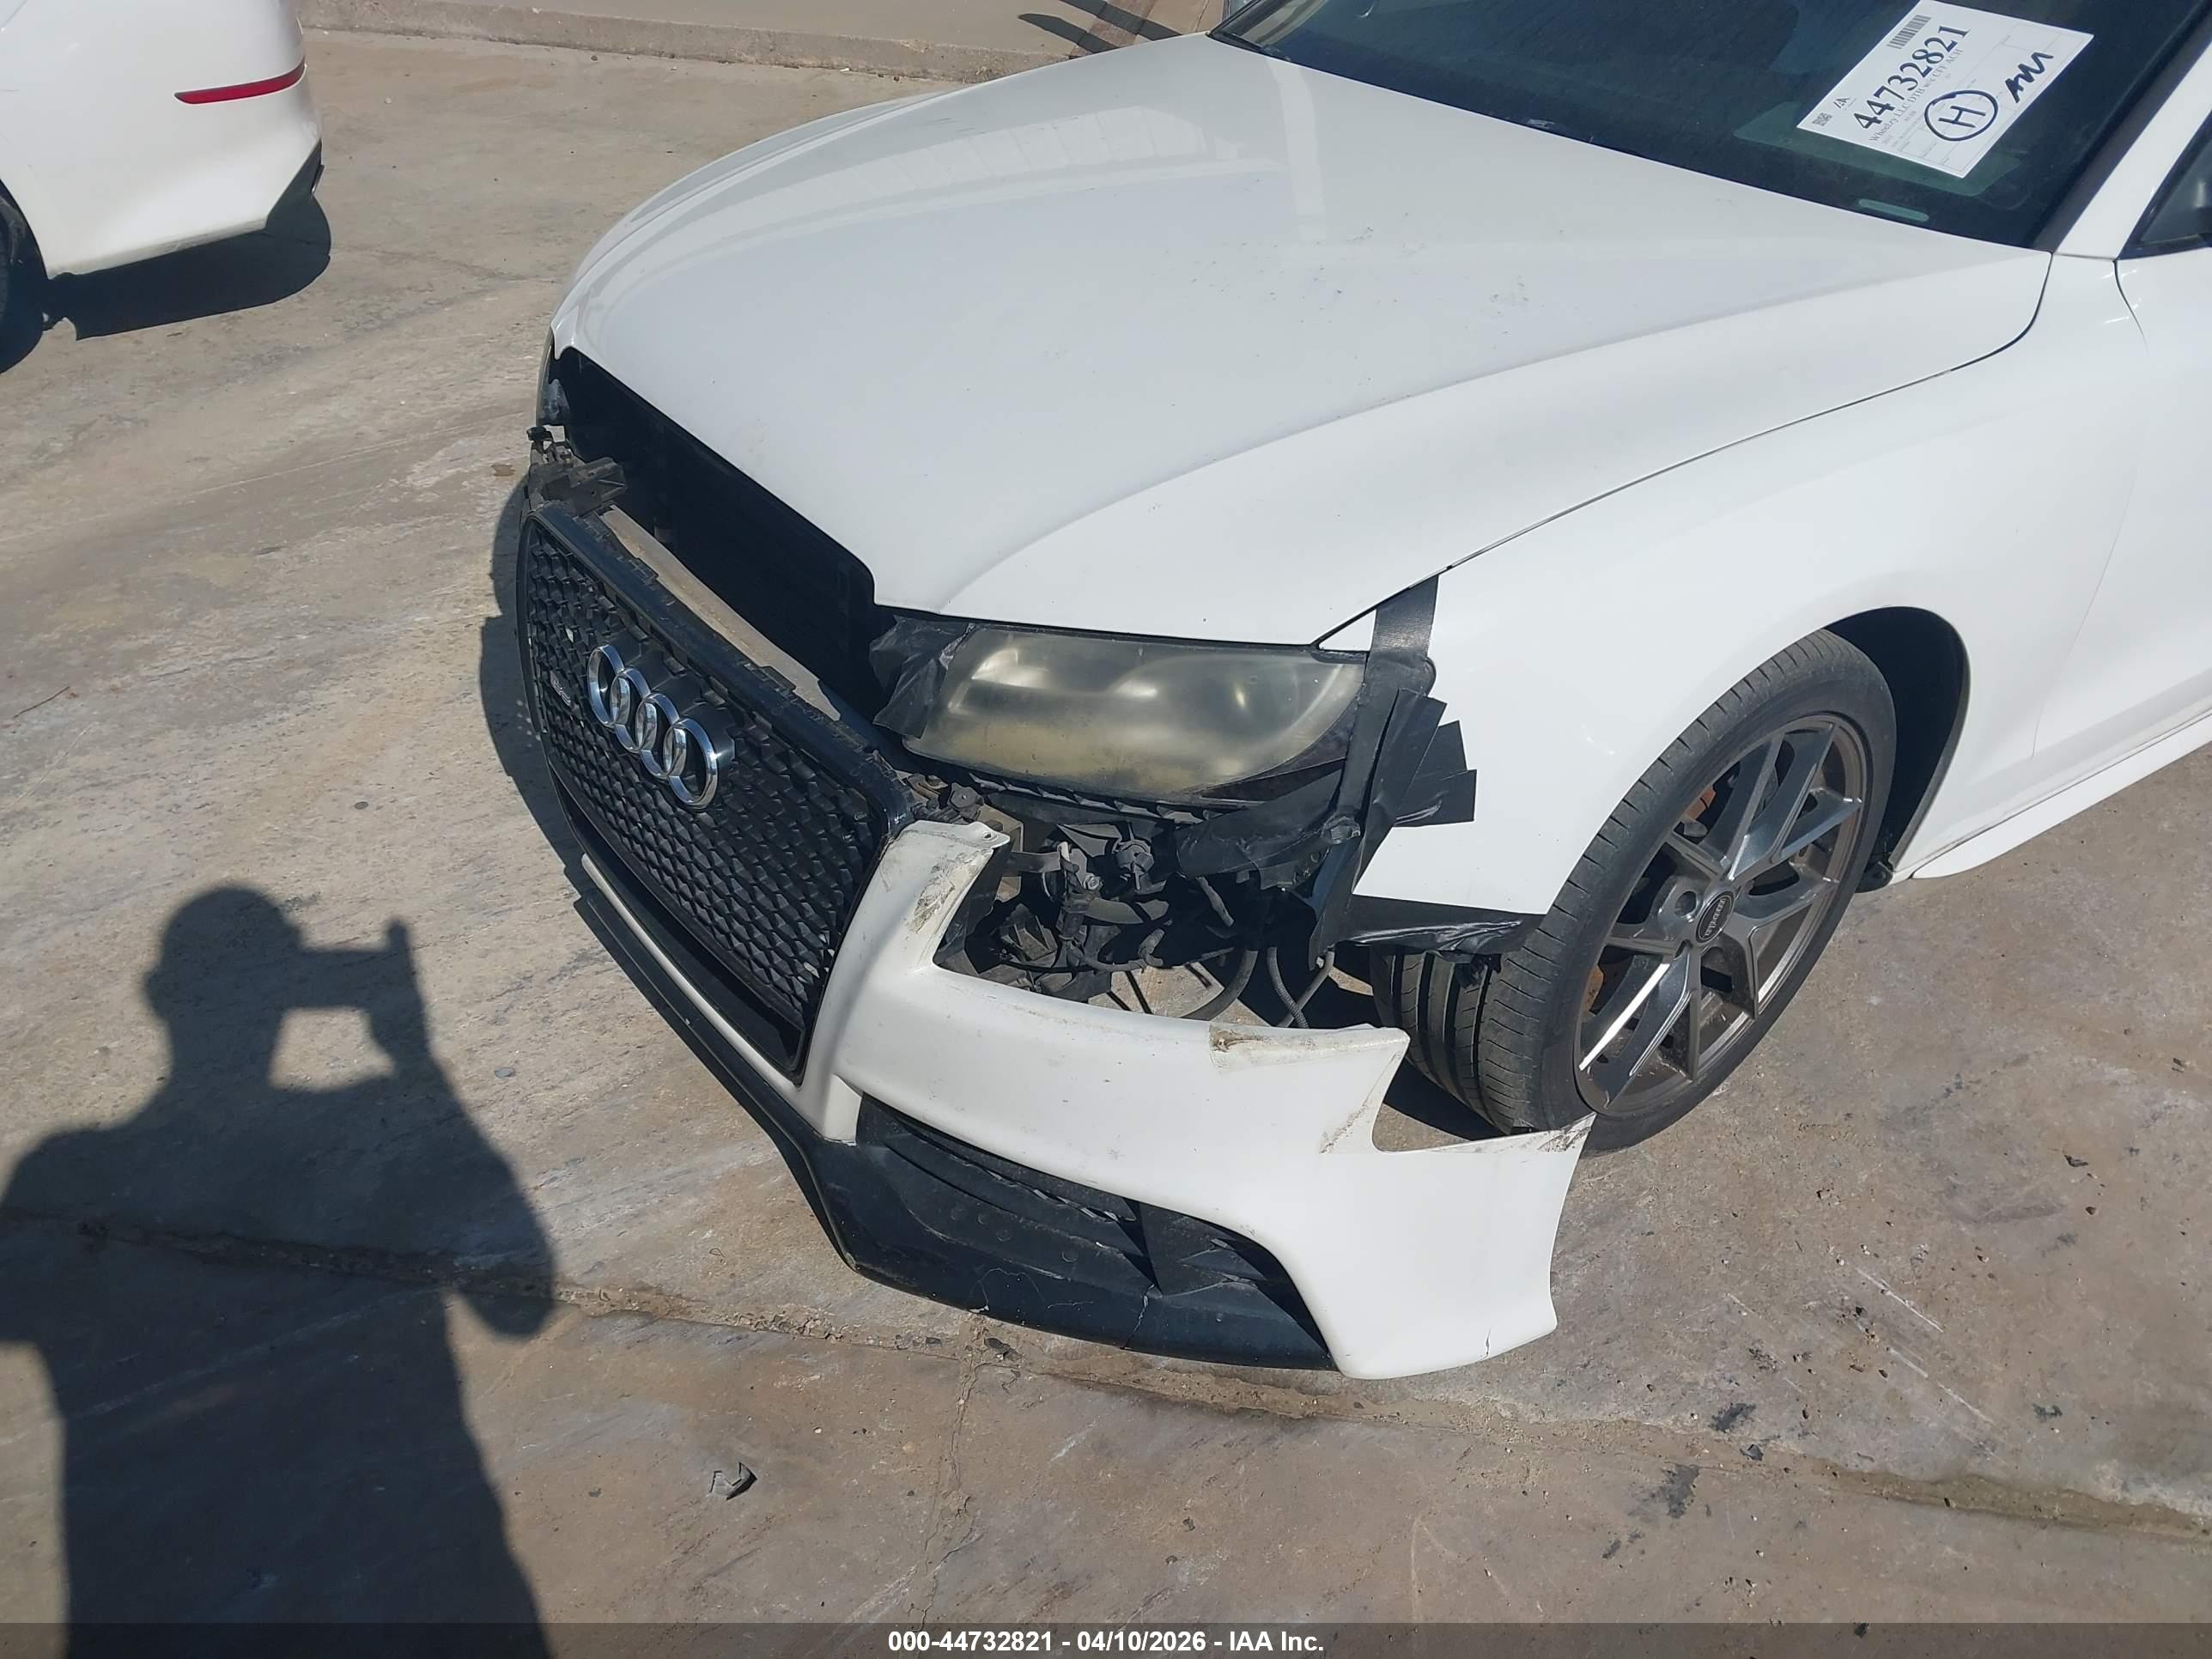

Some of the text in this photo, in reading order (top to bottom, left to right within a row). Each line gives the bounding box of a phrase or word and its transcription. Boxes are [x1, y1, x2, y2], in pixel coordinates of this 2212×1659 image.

[1853, 25, 1972, 131] 44732821
[1894, 102, 1911, 117] LLC
[1937, 104, 1987, 129] H
